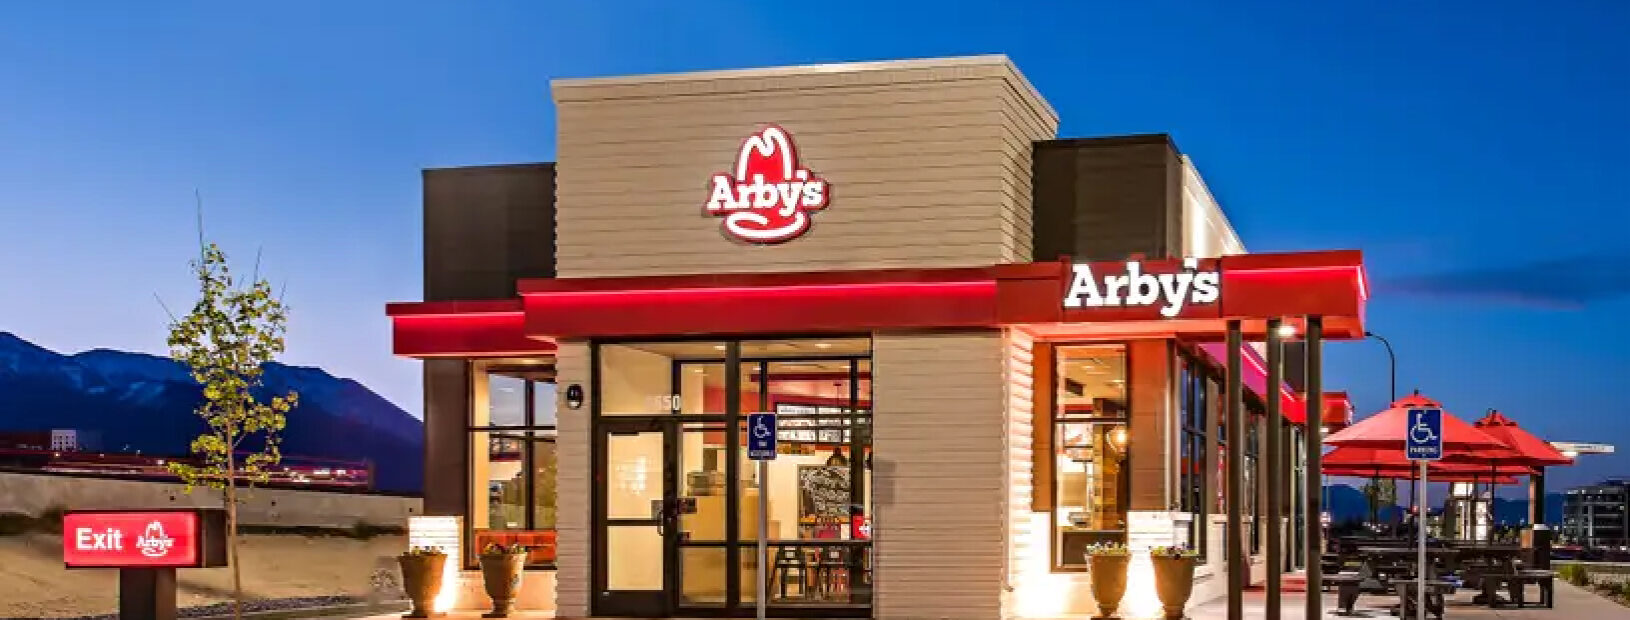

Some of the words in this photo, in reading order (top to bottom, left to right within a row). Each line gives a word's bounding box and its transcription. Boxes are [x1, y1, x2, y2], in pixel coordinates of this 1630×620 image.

[707, 170, 823, 216] Arby's
[1063, 256, 1221, 317] Arby's
[76, 527, 124, 551] Exit
